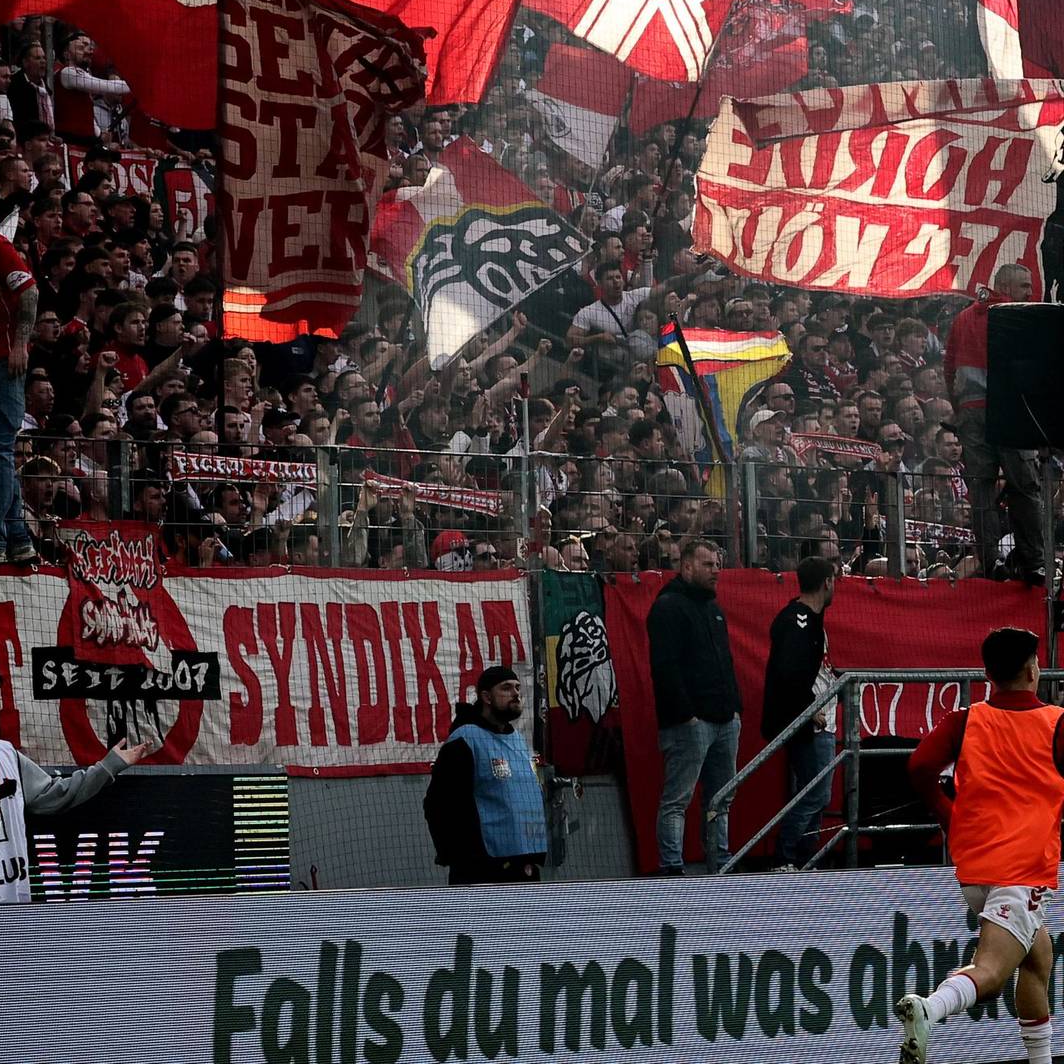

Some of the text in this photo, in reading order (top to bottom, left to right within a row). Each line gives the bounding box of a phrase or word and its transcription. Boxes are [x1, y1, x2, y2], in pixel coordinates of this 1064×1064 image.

[223, 600, 527, 747] SYNDIKAT
[212, 939, 404, 1064] Falls
[422, 934, 521, 1064] du
[538, 922, 676, 1053] mal
[691, 945, 834, 1042] was
